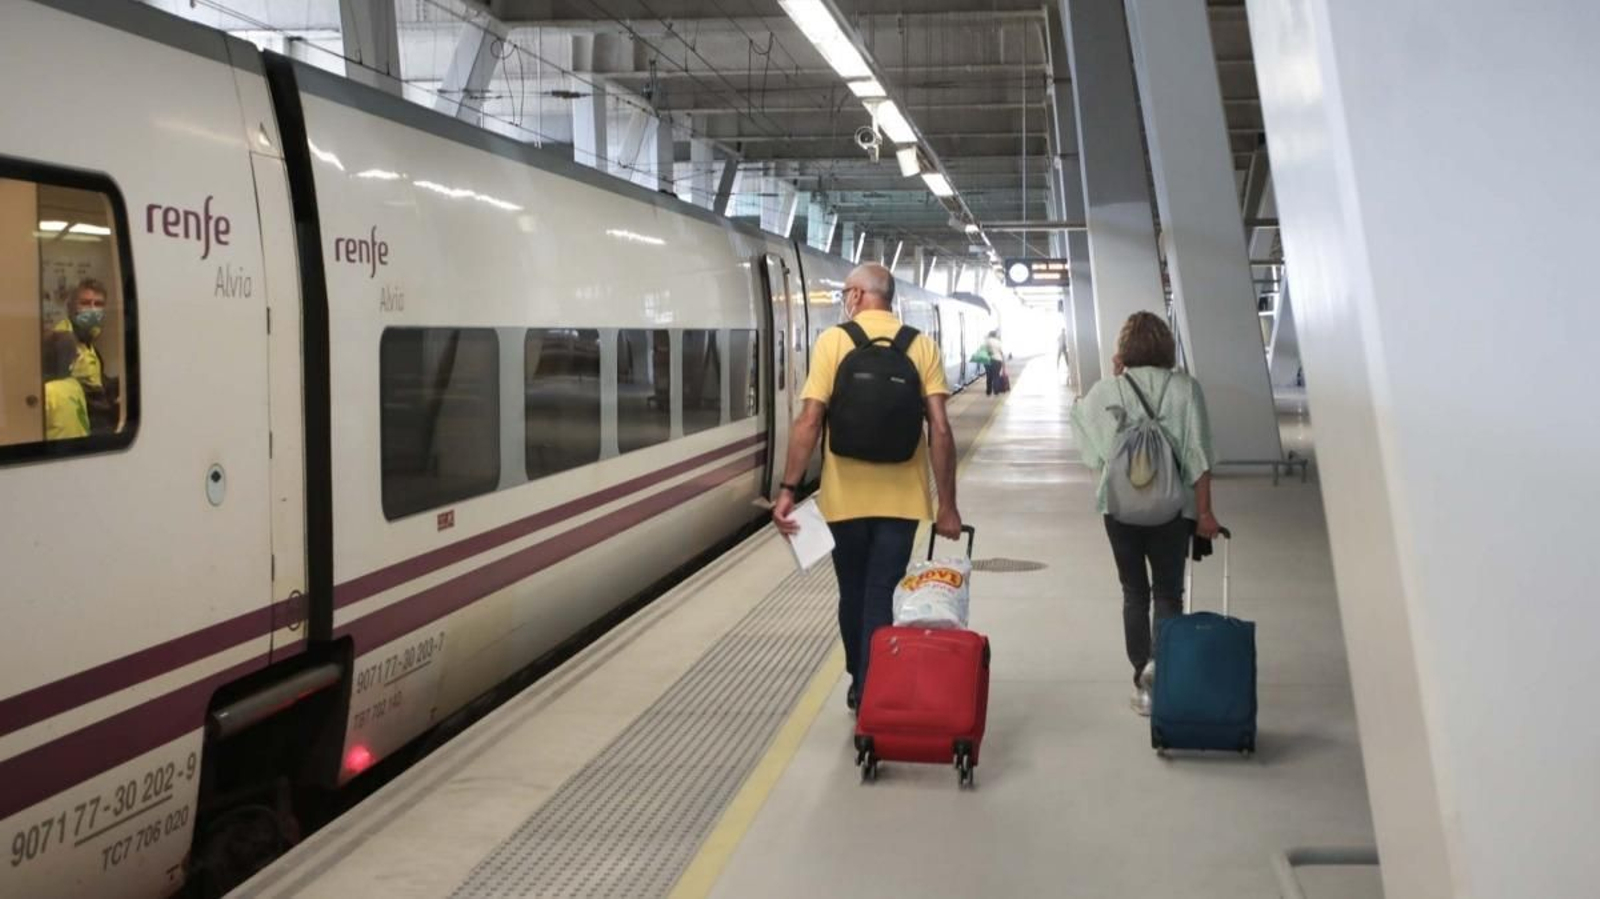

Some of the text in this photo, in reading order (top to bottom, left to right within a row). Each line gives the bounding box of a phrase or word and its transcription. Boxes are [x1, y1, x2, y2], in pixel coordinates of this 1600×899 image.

[146, 195, 231, 261] renfe
[335, 225, 389, 279] renfe
[214, 264, 252, 299] Alvia
[102, 804, 190, 872] TC7 706 020
